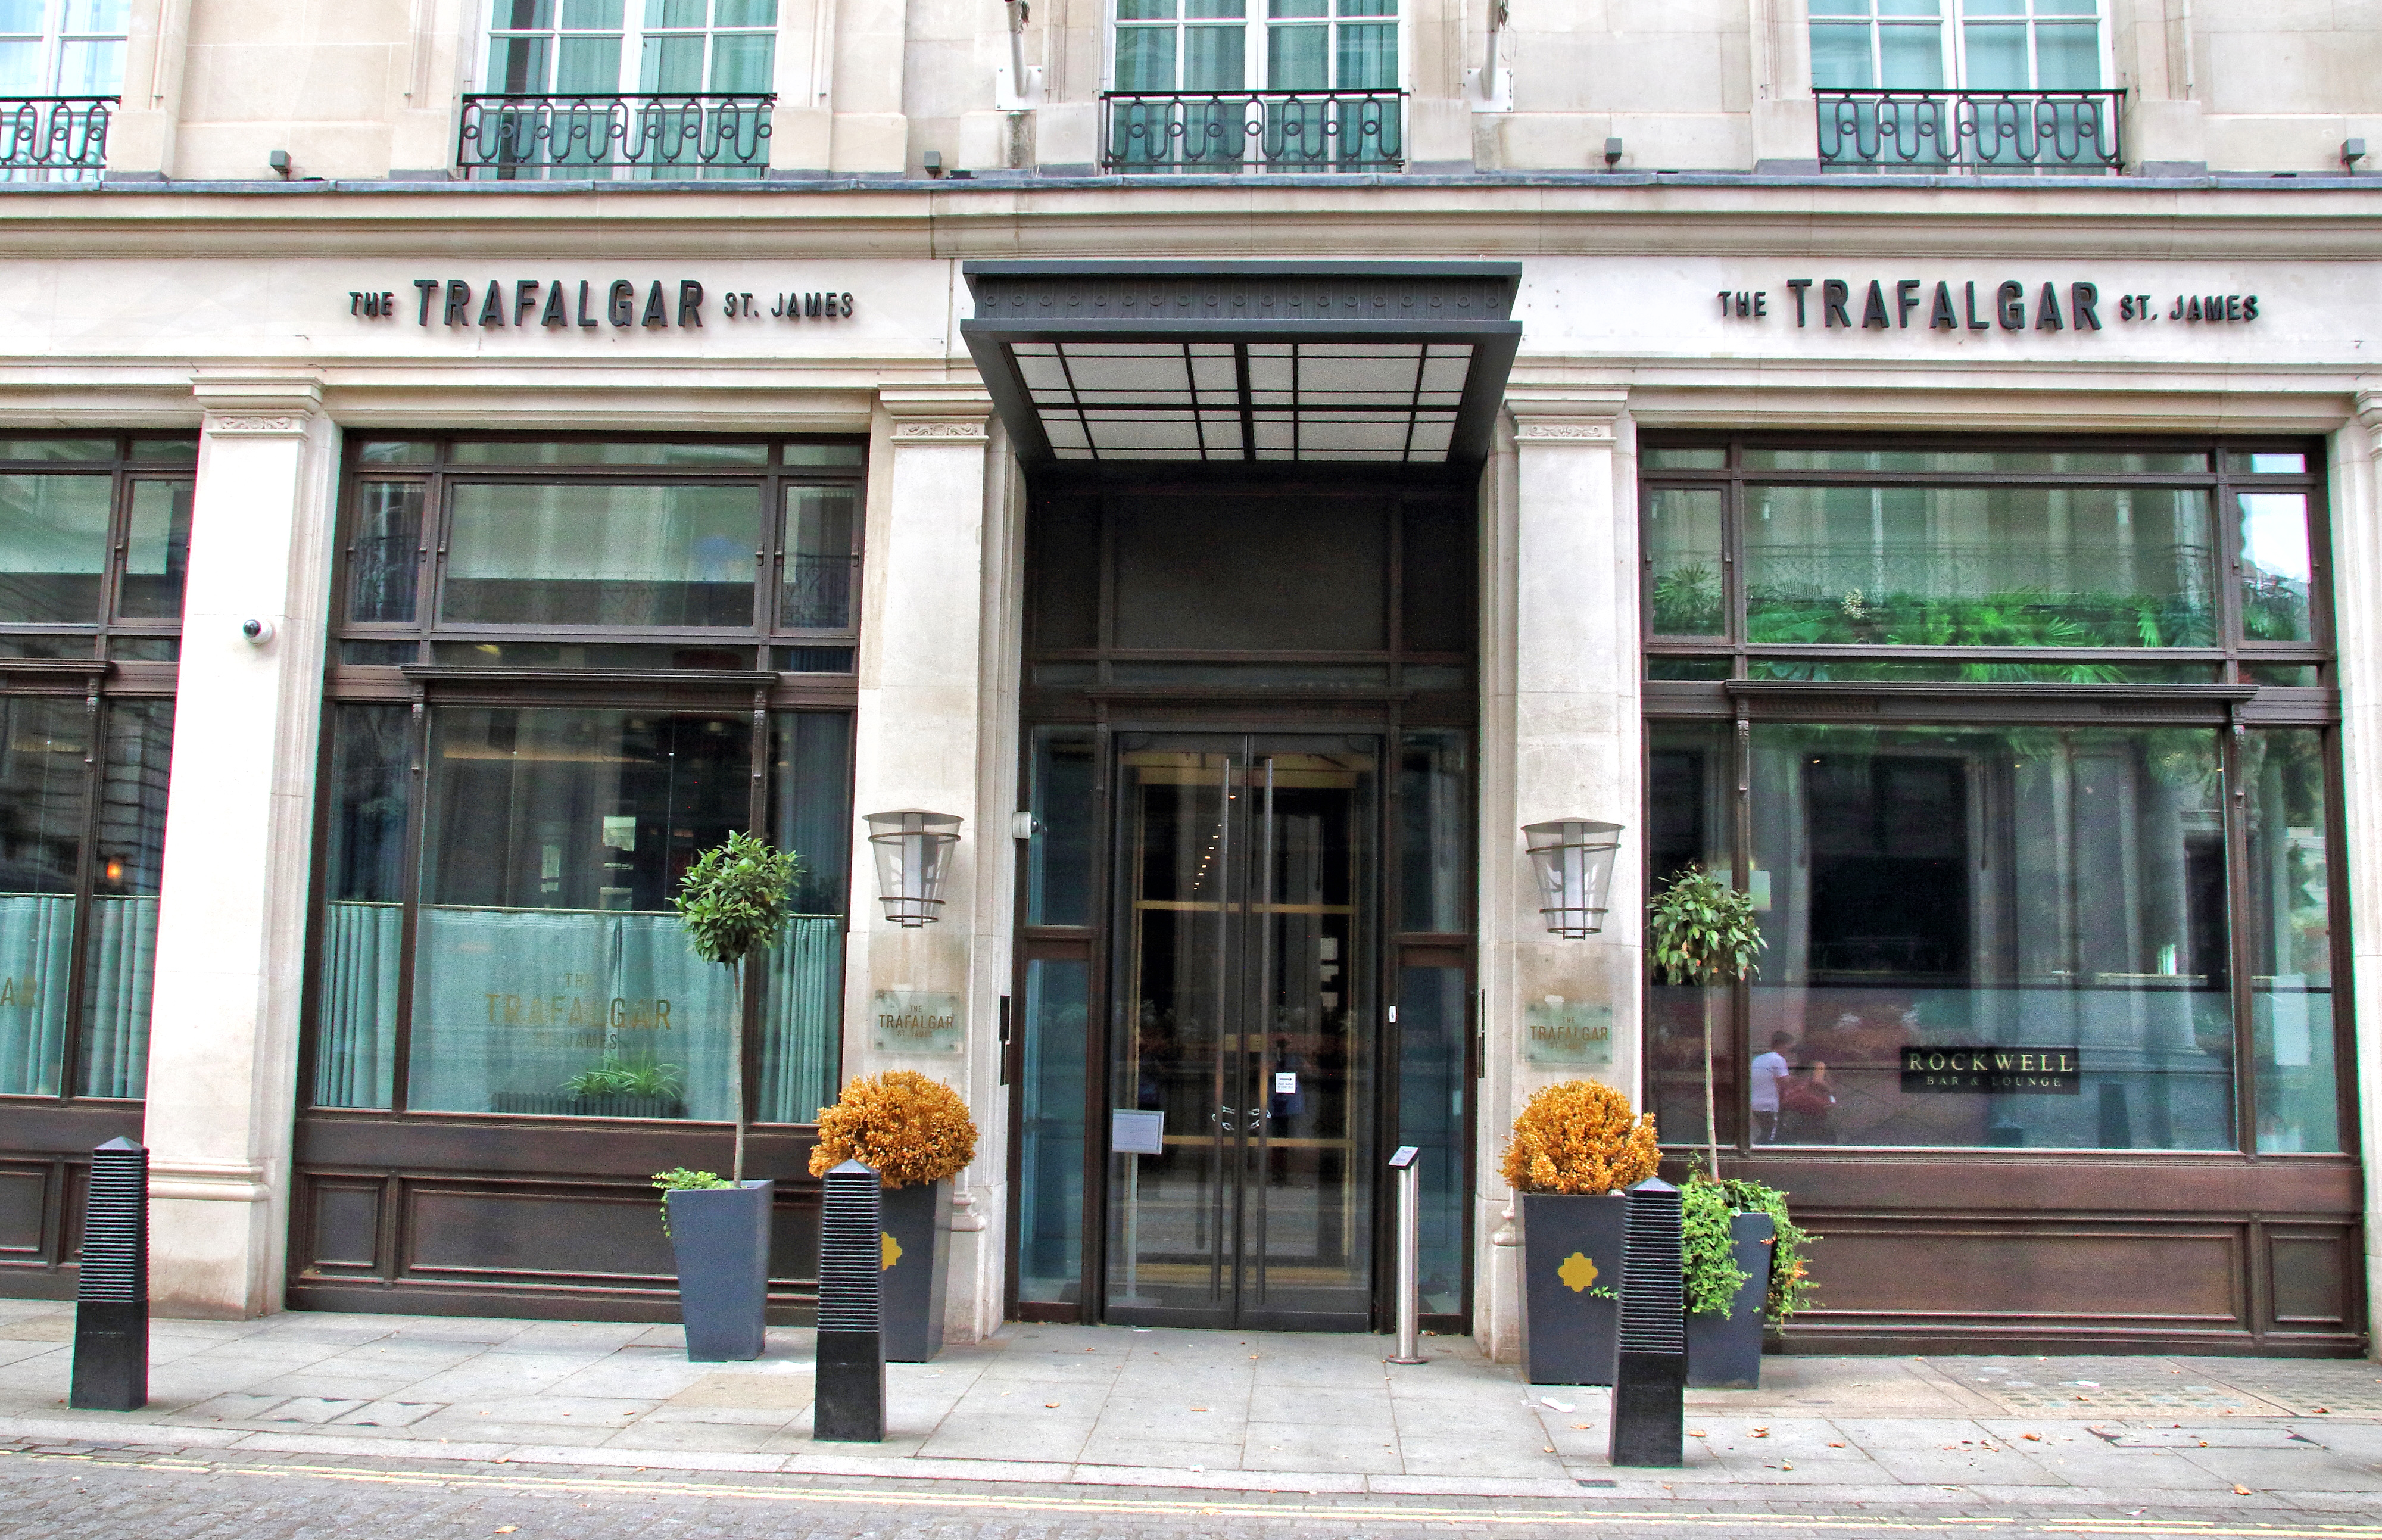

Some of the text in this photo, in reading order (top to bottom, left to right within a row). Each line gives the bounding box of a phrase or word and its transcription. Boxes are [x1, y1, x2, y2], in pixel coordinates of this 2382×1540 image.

[349, 280, 854, 328] THE TRAFALGAR ST. JAMES
[1718, 279, 2259, 331] THE TRAFALGAR ST. JAMES
[878, 1014, 954, 1030] TRAFALGAR
[1530, 1025, 1608, 1041] TRAFALGAR
[1909, 1053, 2074, 1071] ROCKWELL
[1927, 1076, 2061, 1087] BAR & LOUNGE
